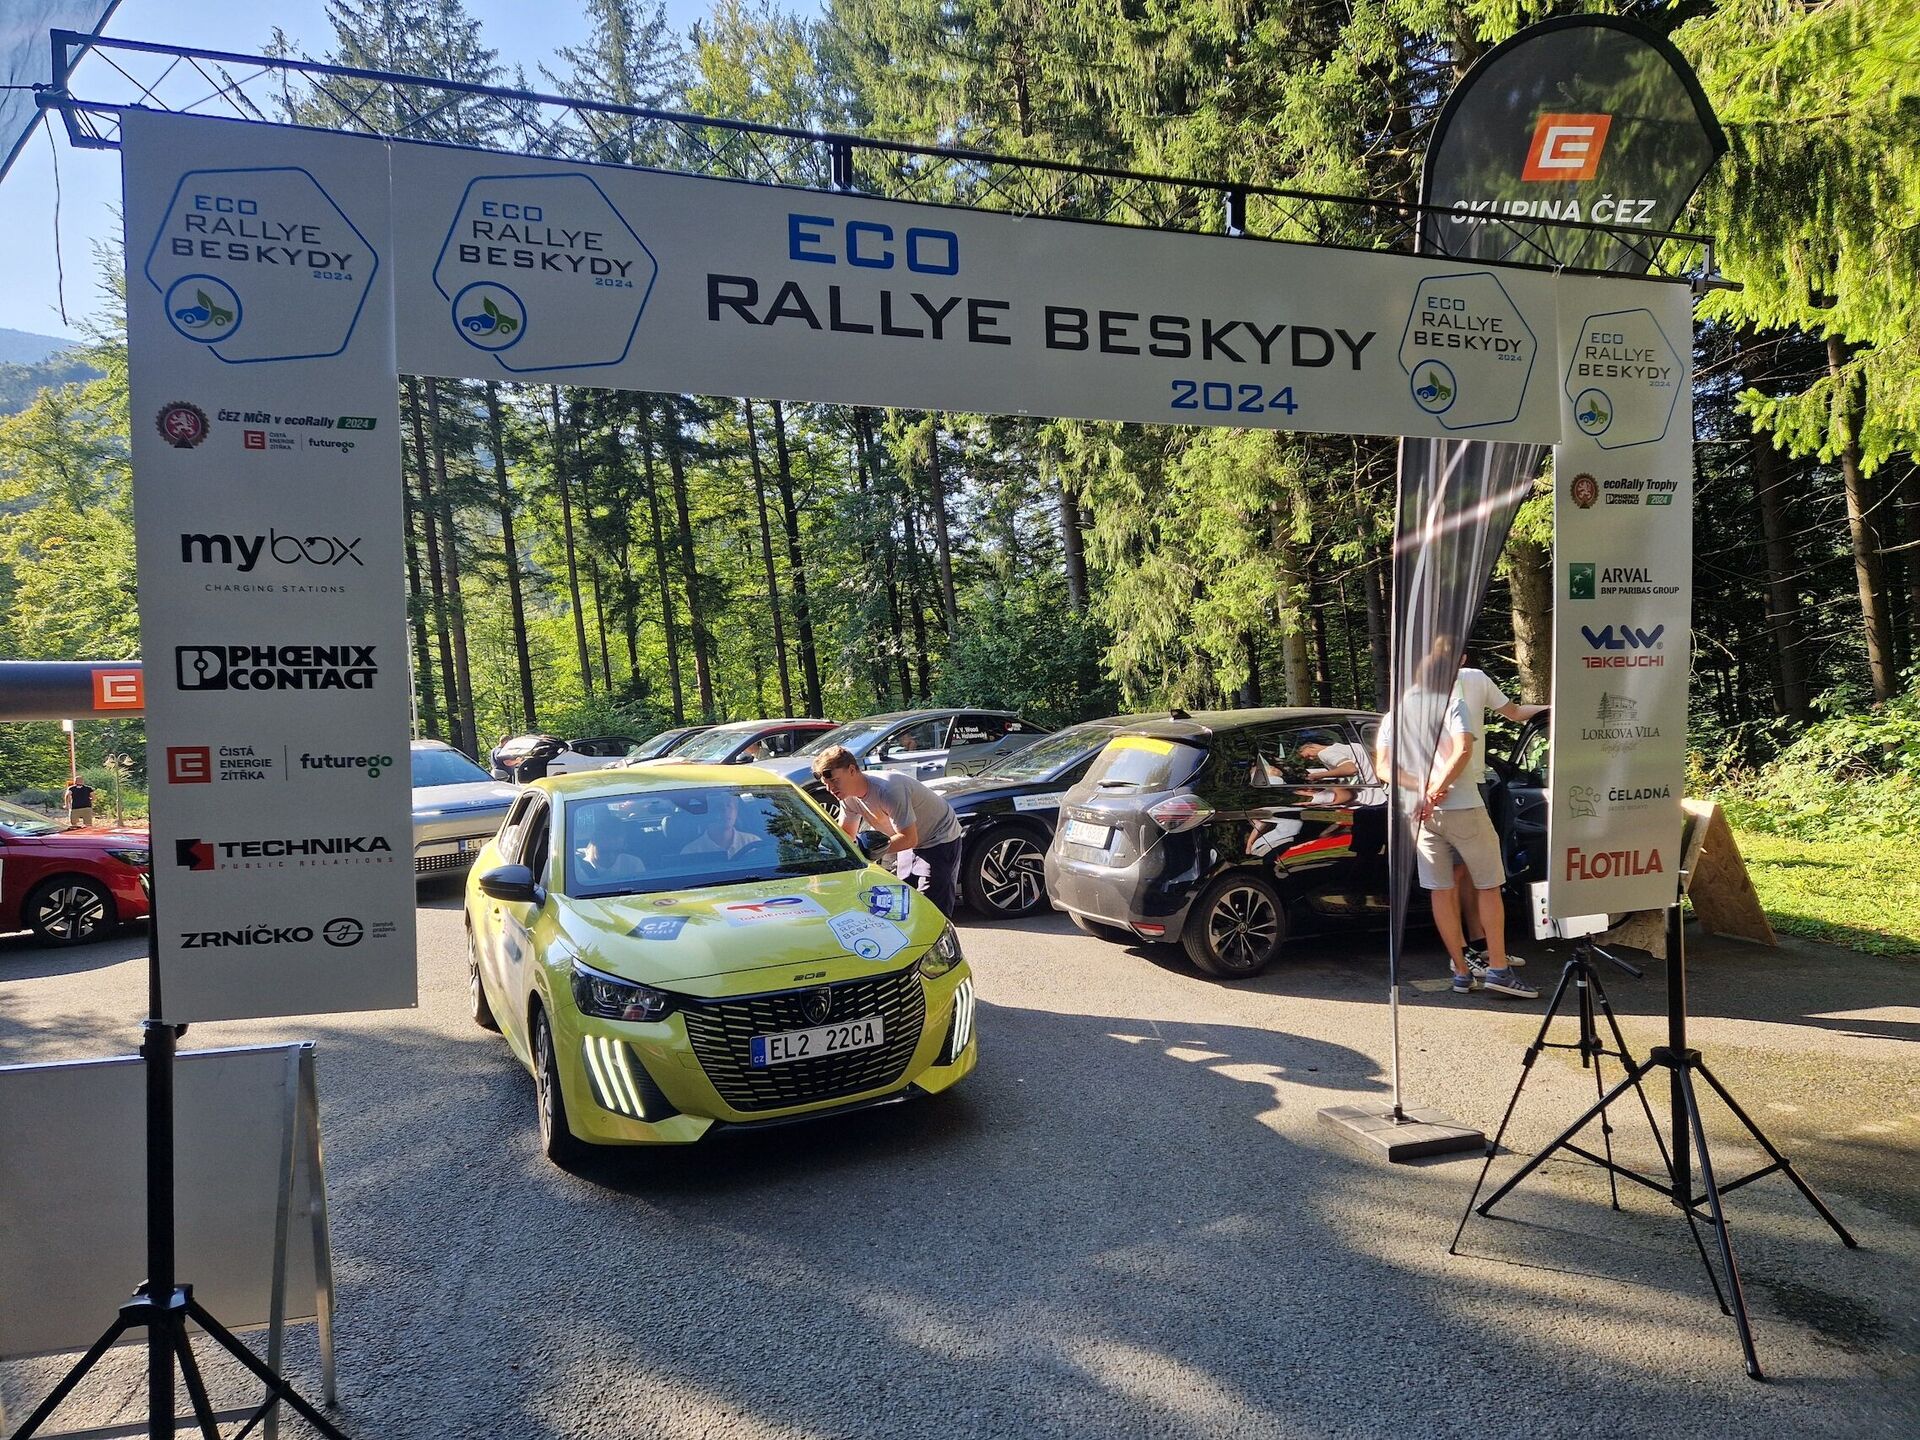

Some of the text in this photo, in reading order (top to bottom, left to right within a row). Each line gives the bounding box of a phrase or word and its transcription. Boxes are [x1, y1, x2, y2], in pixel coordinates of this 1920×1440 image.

[195, 195, 257, 215] ECO
[482, 201, 543, 222] ECO
[1590, 194, 1657, 223] ČEZ
[185, 214, 321, 244] RALLYE
[472, 220, 603, 251] RALLYE
[172, 238, 352, 270] BESKYDY
[788, 213, 959, 276] ECO
[459, 244, 633, 278] BESKYDY
[313, 271, 353, 281] 2024
[595, 277, 633, 288] 2024
[1428, 296, 1465, 311] ECO
[707, 273, 1377, 370] RALLYE BESKYDY
[1422, 311, 1503, 333] RALLYE
[1414, 331, 1522, 353] BESKYDY
[1591, 332, 1623, 345] ECO
[1498, 353, 1522, 362] 2024
[1585, 346, 1655, 362] RALLYE
[1578, 364, 1671, 380] BESKYDY
[1171, 379, 1299, 415] 2024
[217, 408, 369, 429] ČEZ MČR v ecoRally 2024
[309, 438, 355, 453] futurego
[1603, 478, 1678, 492] ecoRally Trophy
[181, 527, 364, 573] mybox
[1601, 568, 1652, 583] ARVAL
[205, 584, 345, 593] CHARGING STATIONS
[1601, 586, 1679, 595] BNP PARIBAS GROUP
[228, 668, 378, 690] CONTACT
[219, 745, 254, 757] ČISTÁ
[220, 758, 272, 769] ENERGIE
[300, 753, 393, 778] futurego
[220, 769, 265, 781] ZÍTŘKA
[1608, 784, 1670, 801] ČELADNÁ
[218, 836, 392, 858] TECHNIKA
[221, 857, 394, 870] PUBLIC RELATIONS
[1566, 847, 1664, 881] FLOTILA
[180, 924, 314, 949] ZRNÍČKO
[793, 971, 827, 981] 208
[770, 1022, 875, 1061] EL2 22CA
[754, 1055, 764, 1064] CZ
